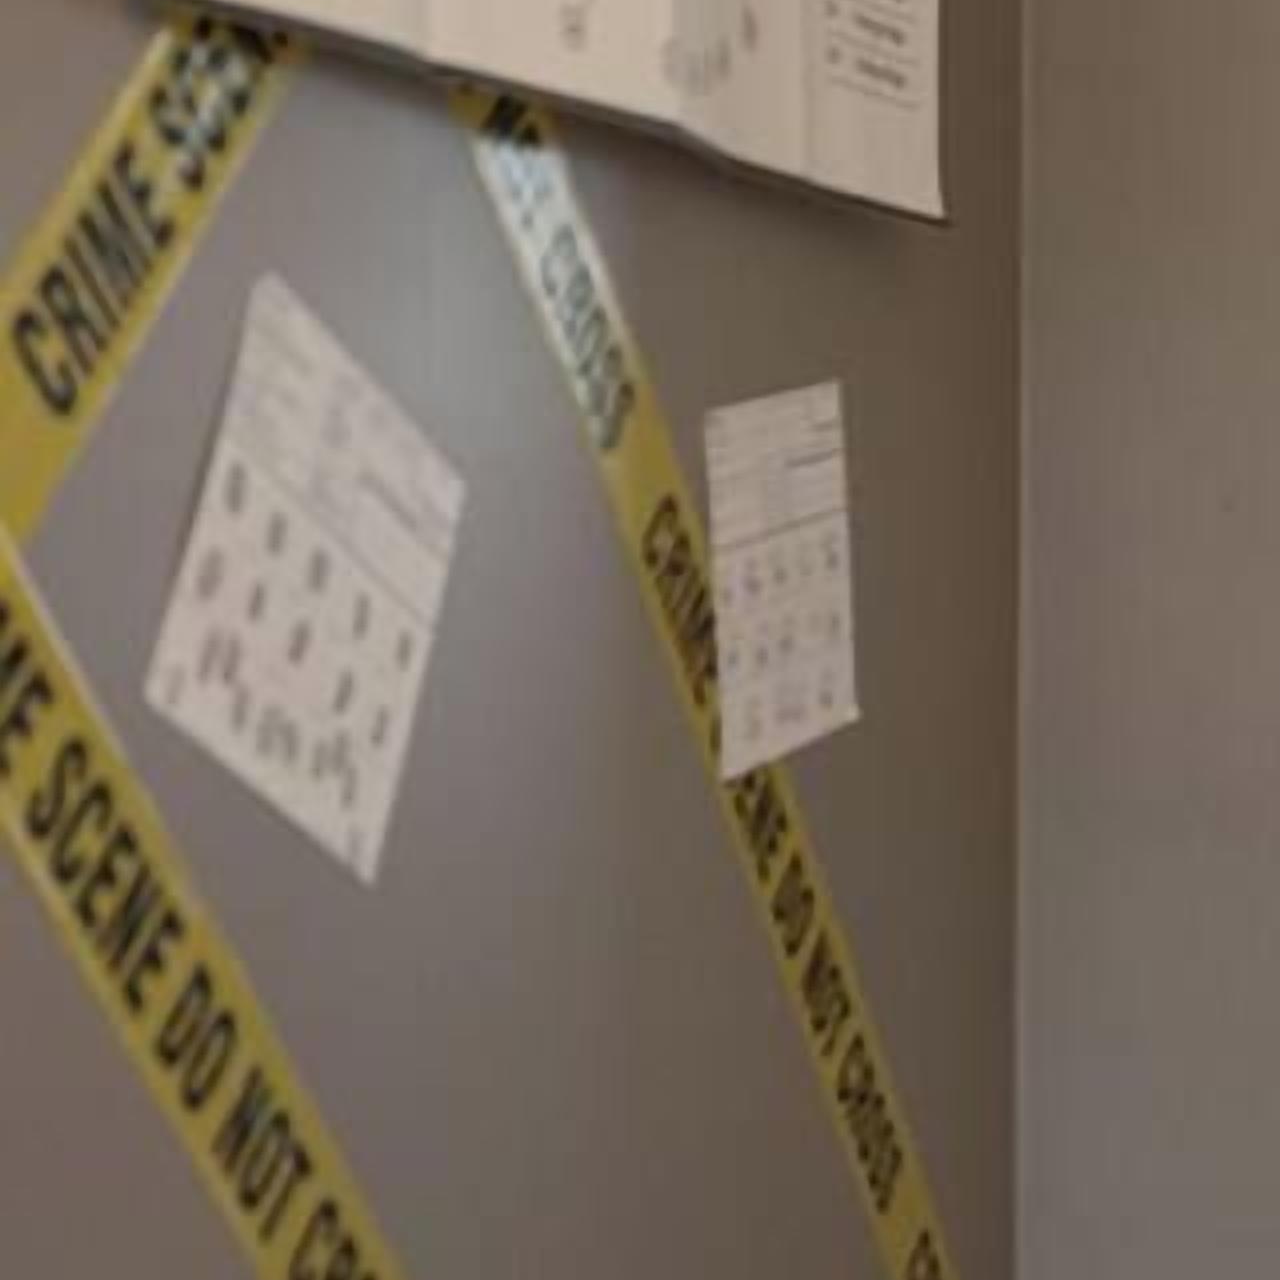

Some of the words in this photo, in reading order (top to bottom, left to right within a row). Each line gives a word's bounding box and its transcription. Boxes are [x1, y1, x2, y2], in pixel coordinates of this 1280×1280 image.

[12, 138, 176, 418] CRIME
[24, 734, 187, 1014] SCENE
[154, 962, 238, 1112] DO
[211, 1065, 314, 1247] NOT
